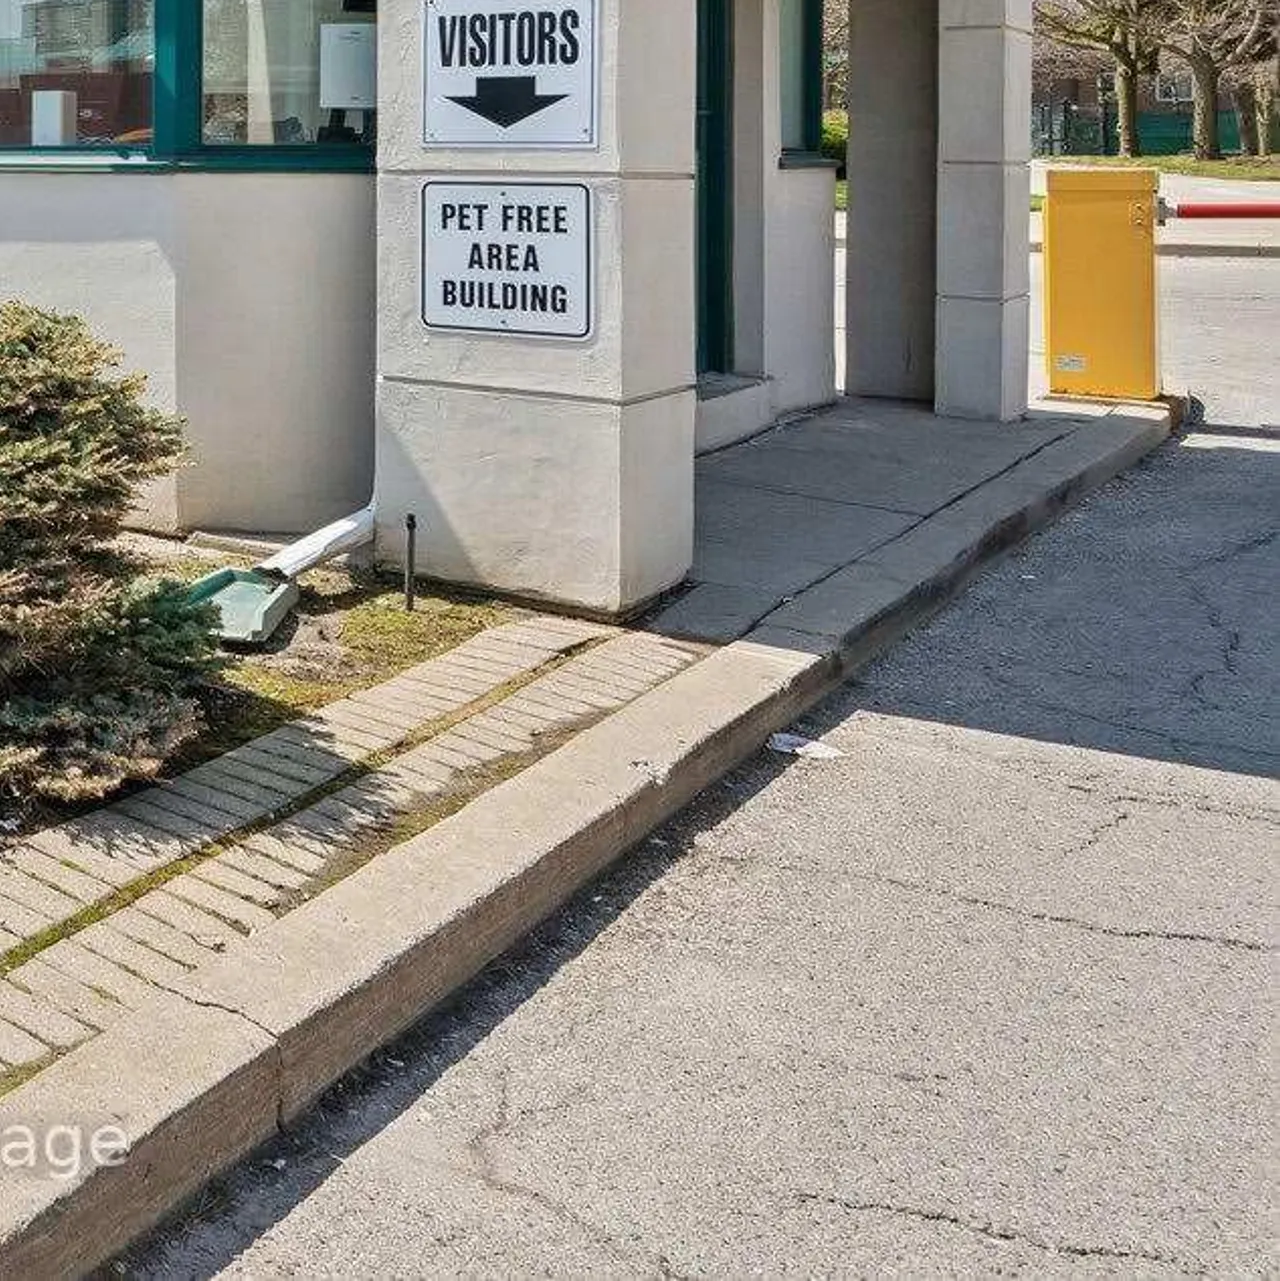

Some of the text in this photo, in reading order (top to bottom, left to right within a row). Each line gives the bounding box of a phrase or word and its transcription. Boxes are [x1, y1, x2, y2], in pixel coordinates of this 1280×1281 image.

[438, 9, 580, 67] VISITORS
[441, 203, 568, 233] PET FREE
[467, 243, 540, 272] AREA
[442, 280, 568, 314] BUILDING
